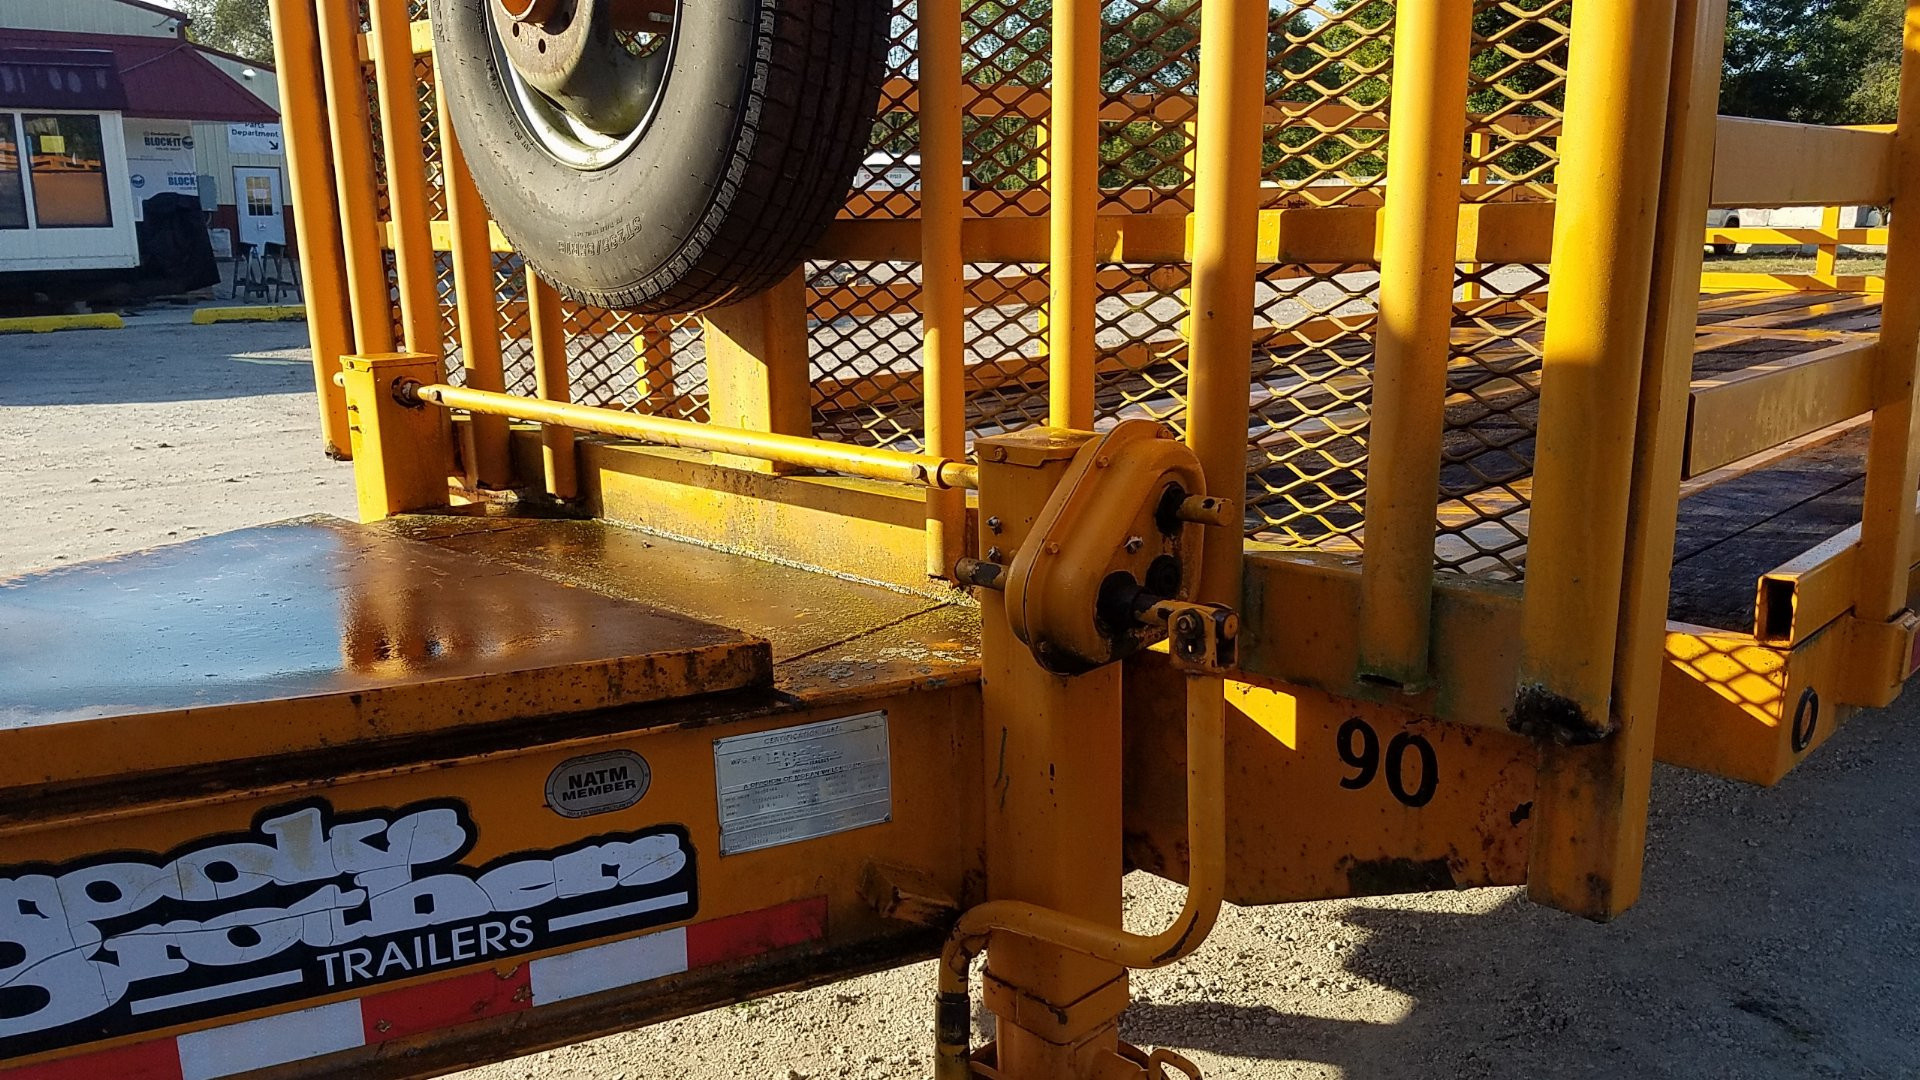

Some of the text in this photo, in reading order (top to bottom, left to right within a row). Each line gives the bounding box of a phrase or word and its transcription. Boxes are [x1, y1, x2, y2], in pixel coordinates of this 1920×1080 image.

[231, 129, 279, 138] Department
[168, 177, 197, 186] BLOCK-
[1337, 717, 1439, 807] 90
[568, 766, 628, 789] NATM
[562, 780, 636, 801] MEMBER
[317, 914, 534, 987] TRAILERS
